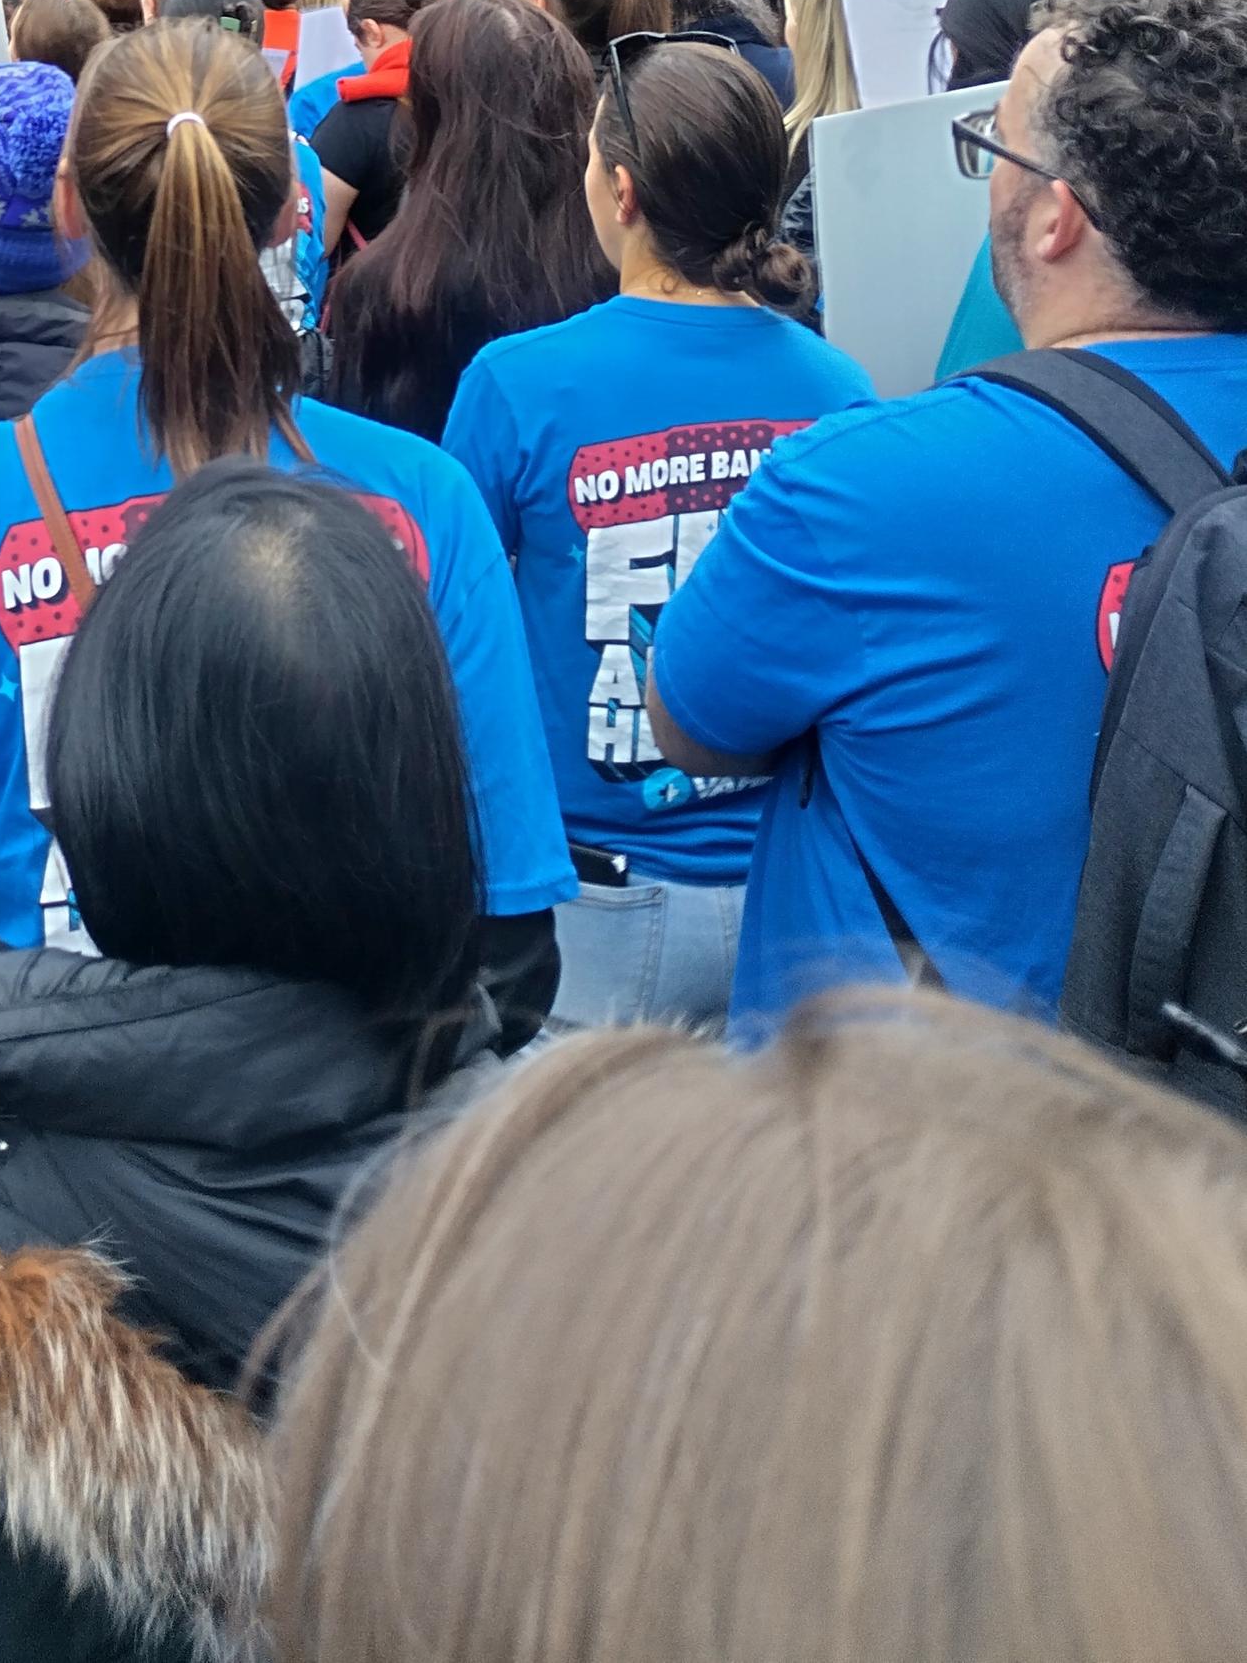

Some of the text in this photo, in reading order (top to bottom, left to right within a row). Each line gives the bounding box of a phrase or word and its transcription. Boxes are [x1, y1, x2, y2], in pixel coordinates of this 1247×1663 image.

[574, 469, 620, 505] NO
[624, 453, 707, 495] MORE
[1, 555, 64, 611] NO
